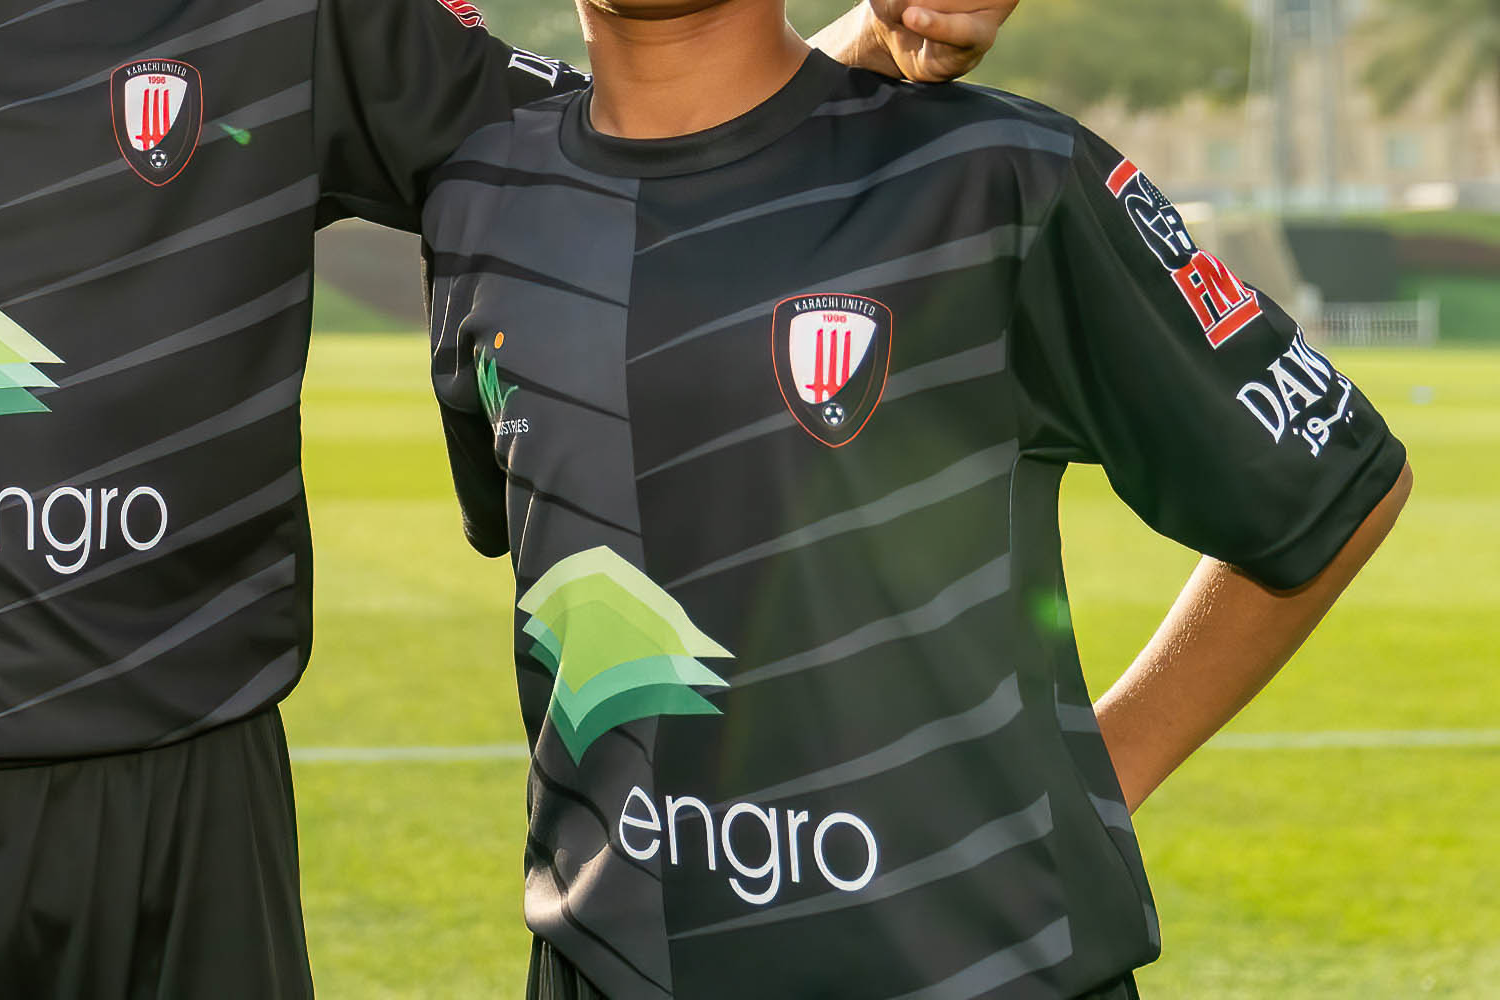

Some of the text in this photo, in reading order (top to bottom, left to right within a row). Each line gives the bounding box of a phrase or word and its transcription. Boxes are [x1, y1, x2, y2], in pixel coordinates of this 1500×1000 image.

[126, 63, 187, 77] KARACHI UNITED
[794, 297, 876, 316] KARACHI UNITED
[1236, 322, 1332, 444] DAW
[619, 785, 878, 905] engro
